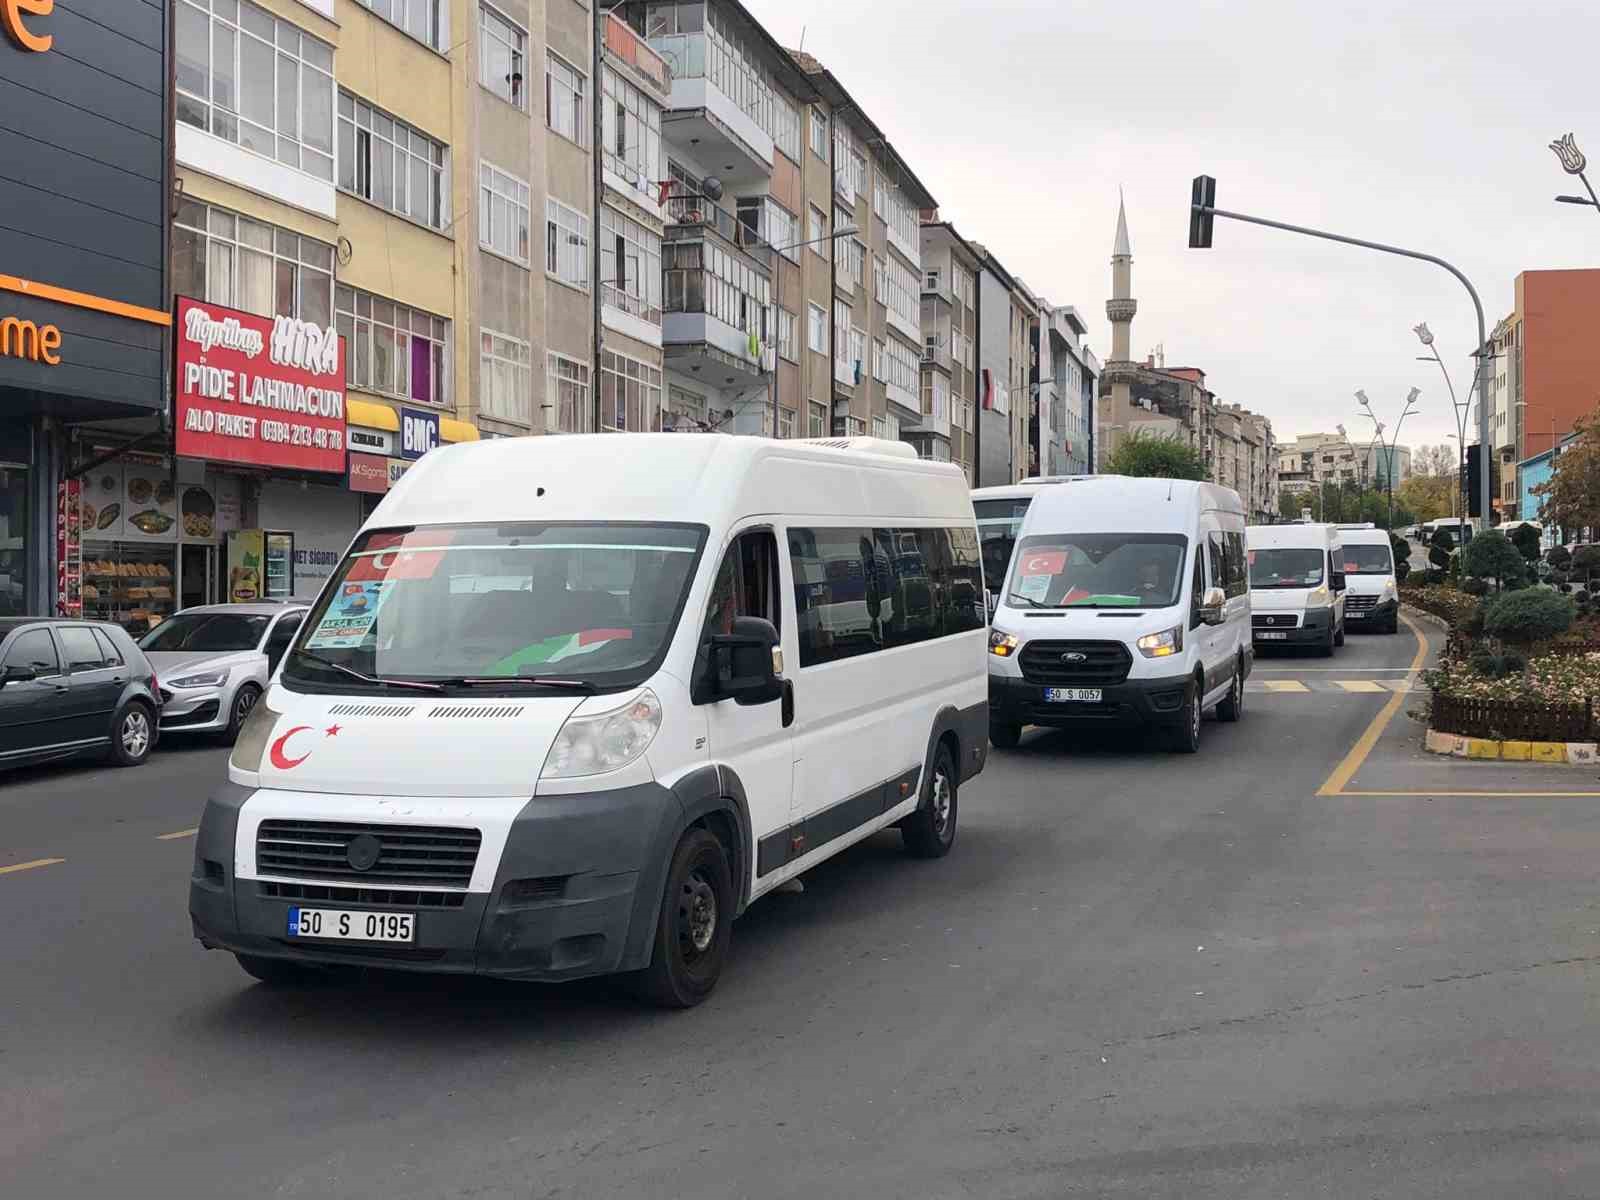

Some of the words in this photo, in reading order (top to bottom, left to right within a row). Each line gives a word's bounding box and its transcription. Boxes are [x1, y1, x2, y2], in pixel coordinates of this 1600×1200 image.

[0, 316, 61, 365] me
[184, 357, 235, 401] PİDE
[239, 373, 343, 419] LAHMACUN
[185, 407, 213, 433] ALO
[215, 412, 257, 439] PAKET
[403, 416, 436, 452] BMC
[1067, 690, 1074, 699] S
[300, 911, 322, 935] 50
[339, 913, 350, 936] S
[366, 914, 410, 939] 0195
